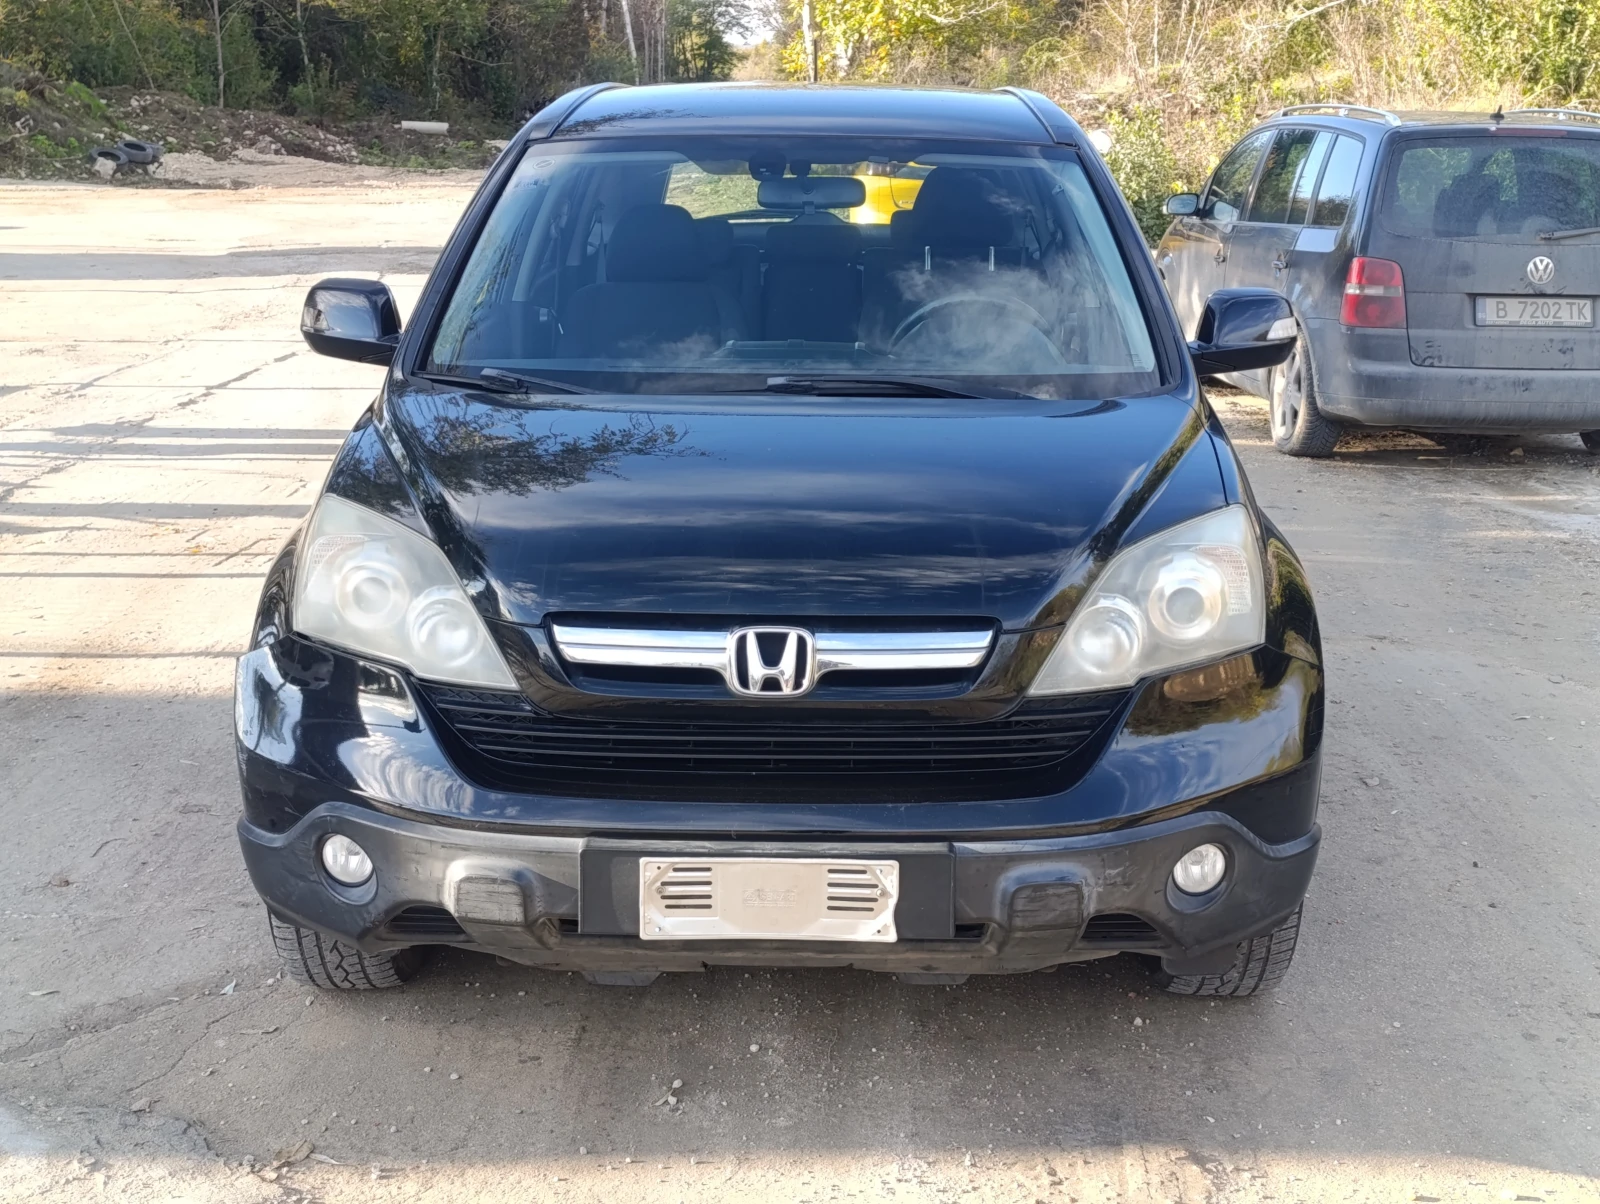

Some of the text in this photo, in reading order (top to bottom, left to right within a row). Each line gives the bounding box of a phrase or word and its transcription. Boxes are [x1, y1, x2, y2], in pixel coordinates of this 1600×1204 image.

[1527, 256, 1555, 284] VW
[1496, 301, 1588, 321] B 7202 TK
[1537, 319, 1554, 327] AUTO
